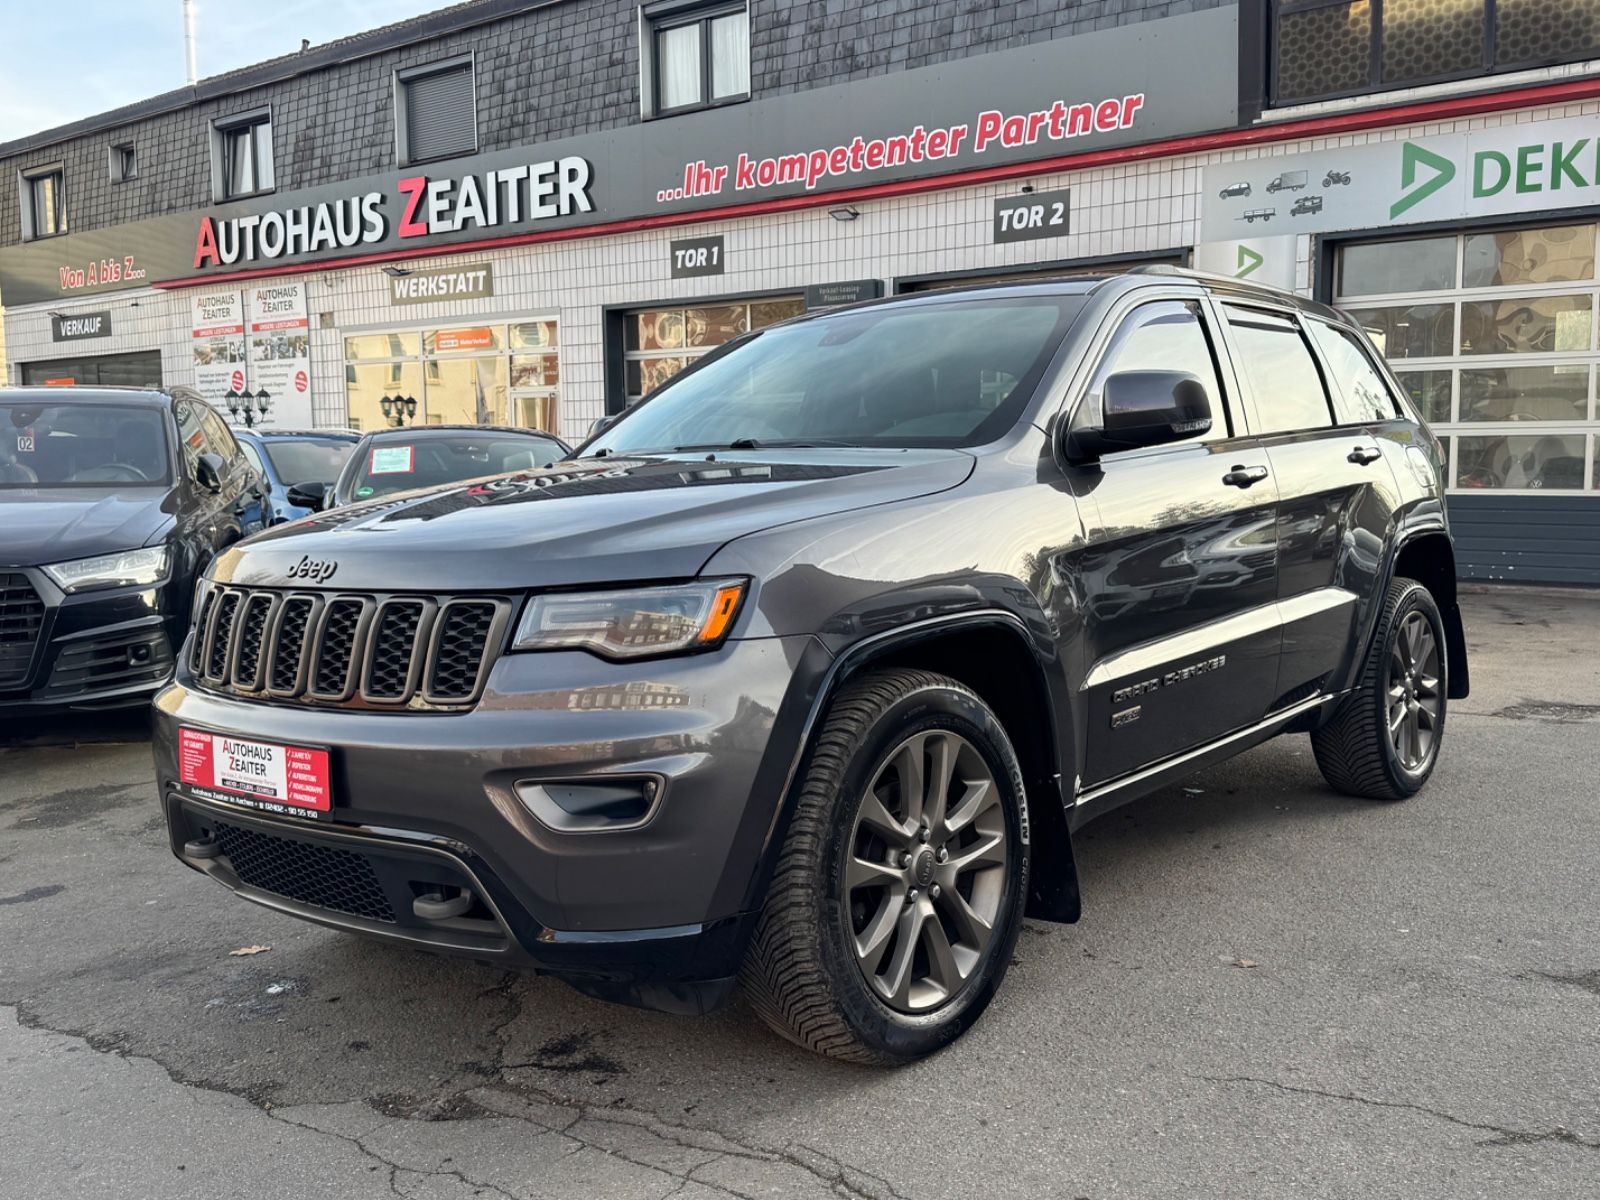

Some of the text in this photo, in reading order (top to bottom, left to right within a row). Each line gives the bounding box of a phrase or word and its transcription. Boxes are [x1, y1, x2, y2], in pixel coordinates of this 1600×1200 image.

[657, 93, 1144, 202] ...Ihr kompetenter Partner
[1473, 136, 1600, 198] DEK
[193, 157, 592, 268] AUTOHAUS ZEAITER
[999, 202, 1064, 231] TOR 2
[675, 246, 719, 268] TOR 1
[60, 266, 84, 290] Von
[87, 262, 98, 286] A
[101, 258, 121, 284] bis
[393, 270, 487, 299] WERKSTATT
[197, 294, 235, 309] AUTOHAUS
[256, 286, 298, 301] AUTOHAUS
[202, 307, 231, 320] ZEAITER
[262, 300, 294, 313] ZEAITER
[60, 317, 102, 337] VERKAUF
[19, 437, 33, 450] 02
[287, 554, 338, 584] Jeep
[1113, 654, 1226, 703] GRAND CHEROKEE
[223, 739, 272, 761] AUTOHAUS
[229, 756, 266, 776] ZEAITER
